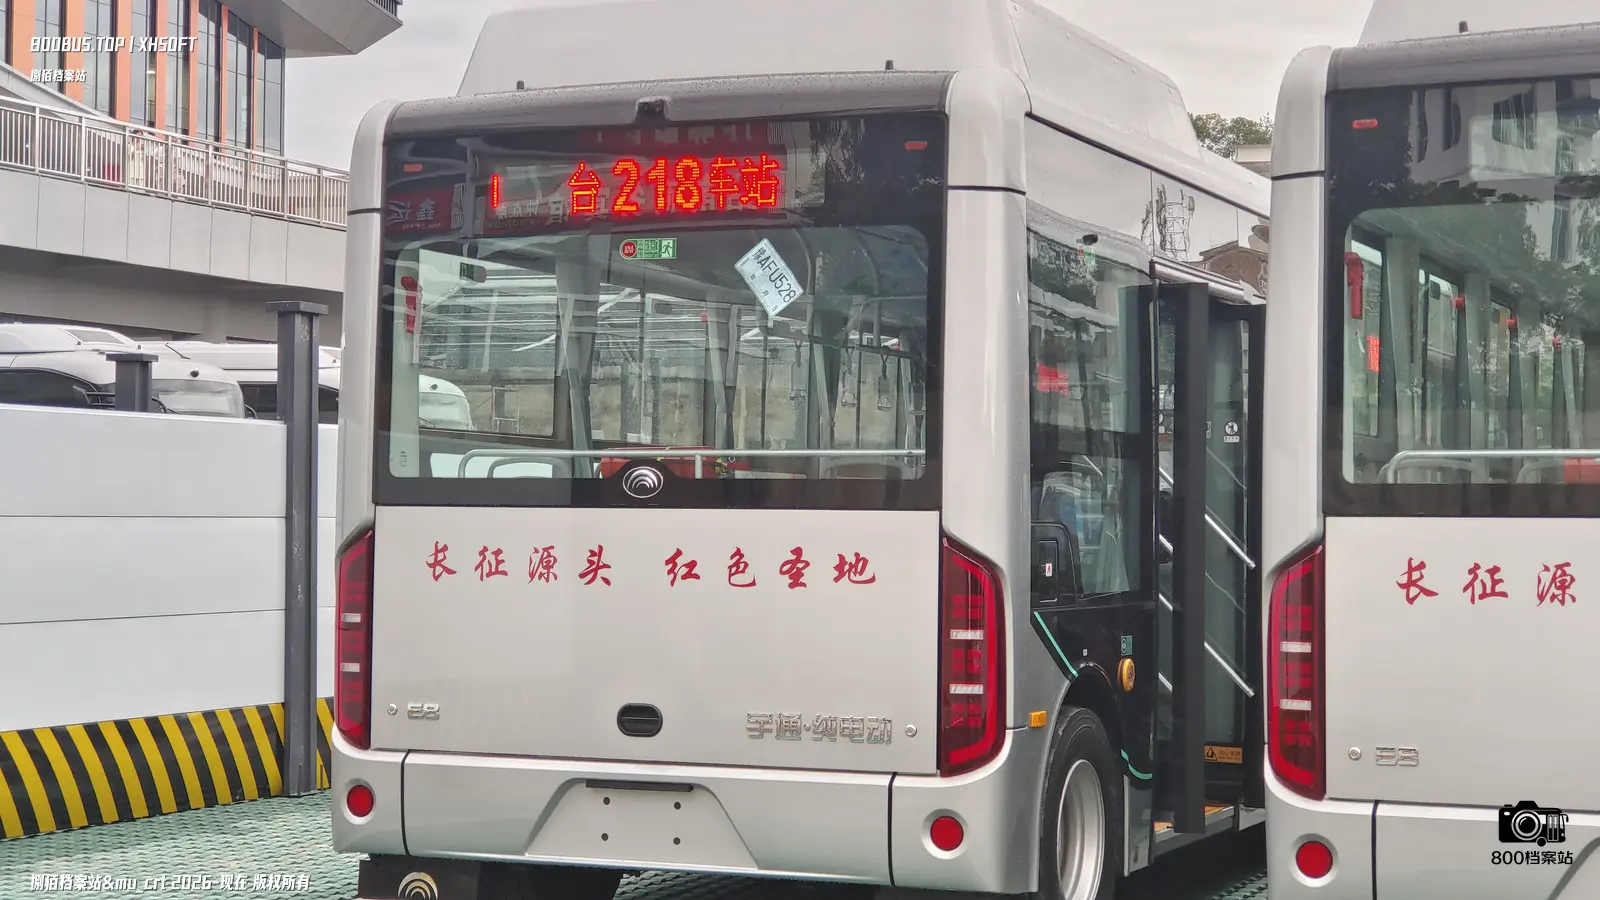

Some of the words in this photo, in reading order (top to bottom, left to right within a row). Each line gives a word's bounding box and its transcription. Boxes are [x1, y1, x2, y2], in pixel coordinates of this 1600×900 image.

[426, 540, 612, 587] 长征源头
[665, 546, 877, 589] 红色圣地
[1396, 557, 1577, 607] 长征源
[407, 703, 440, 720] E8
